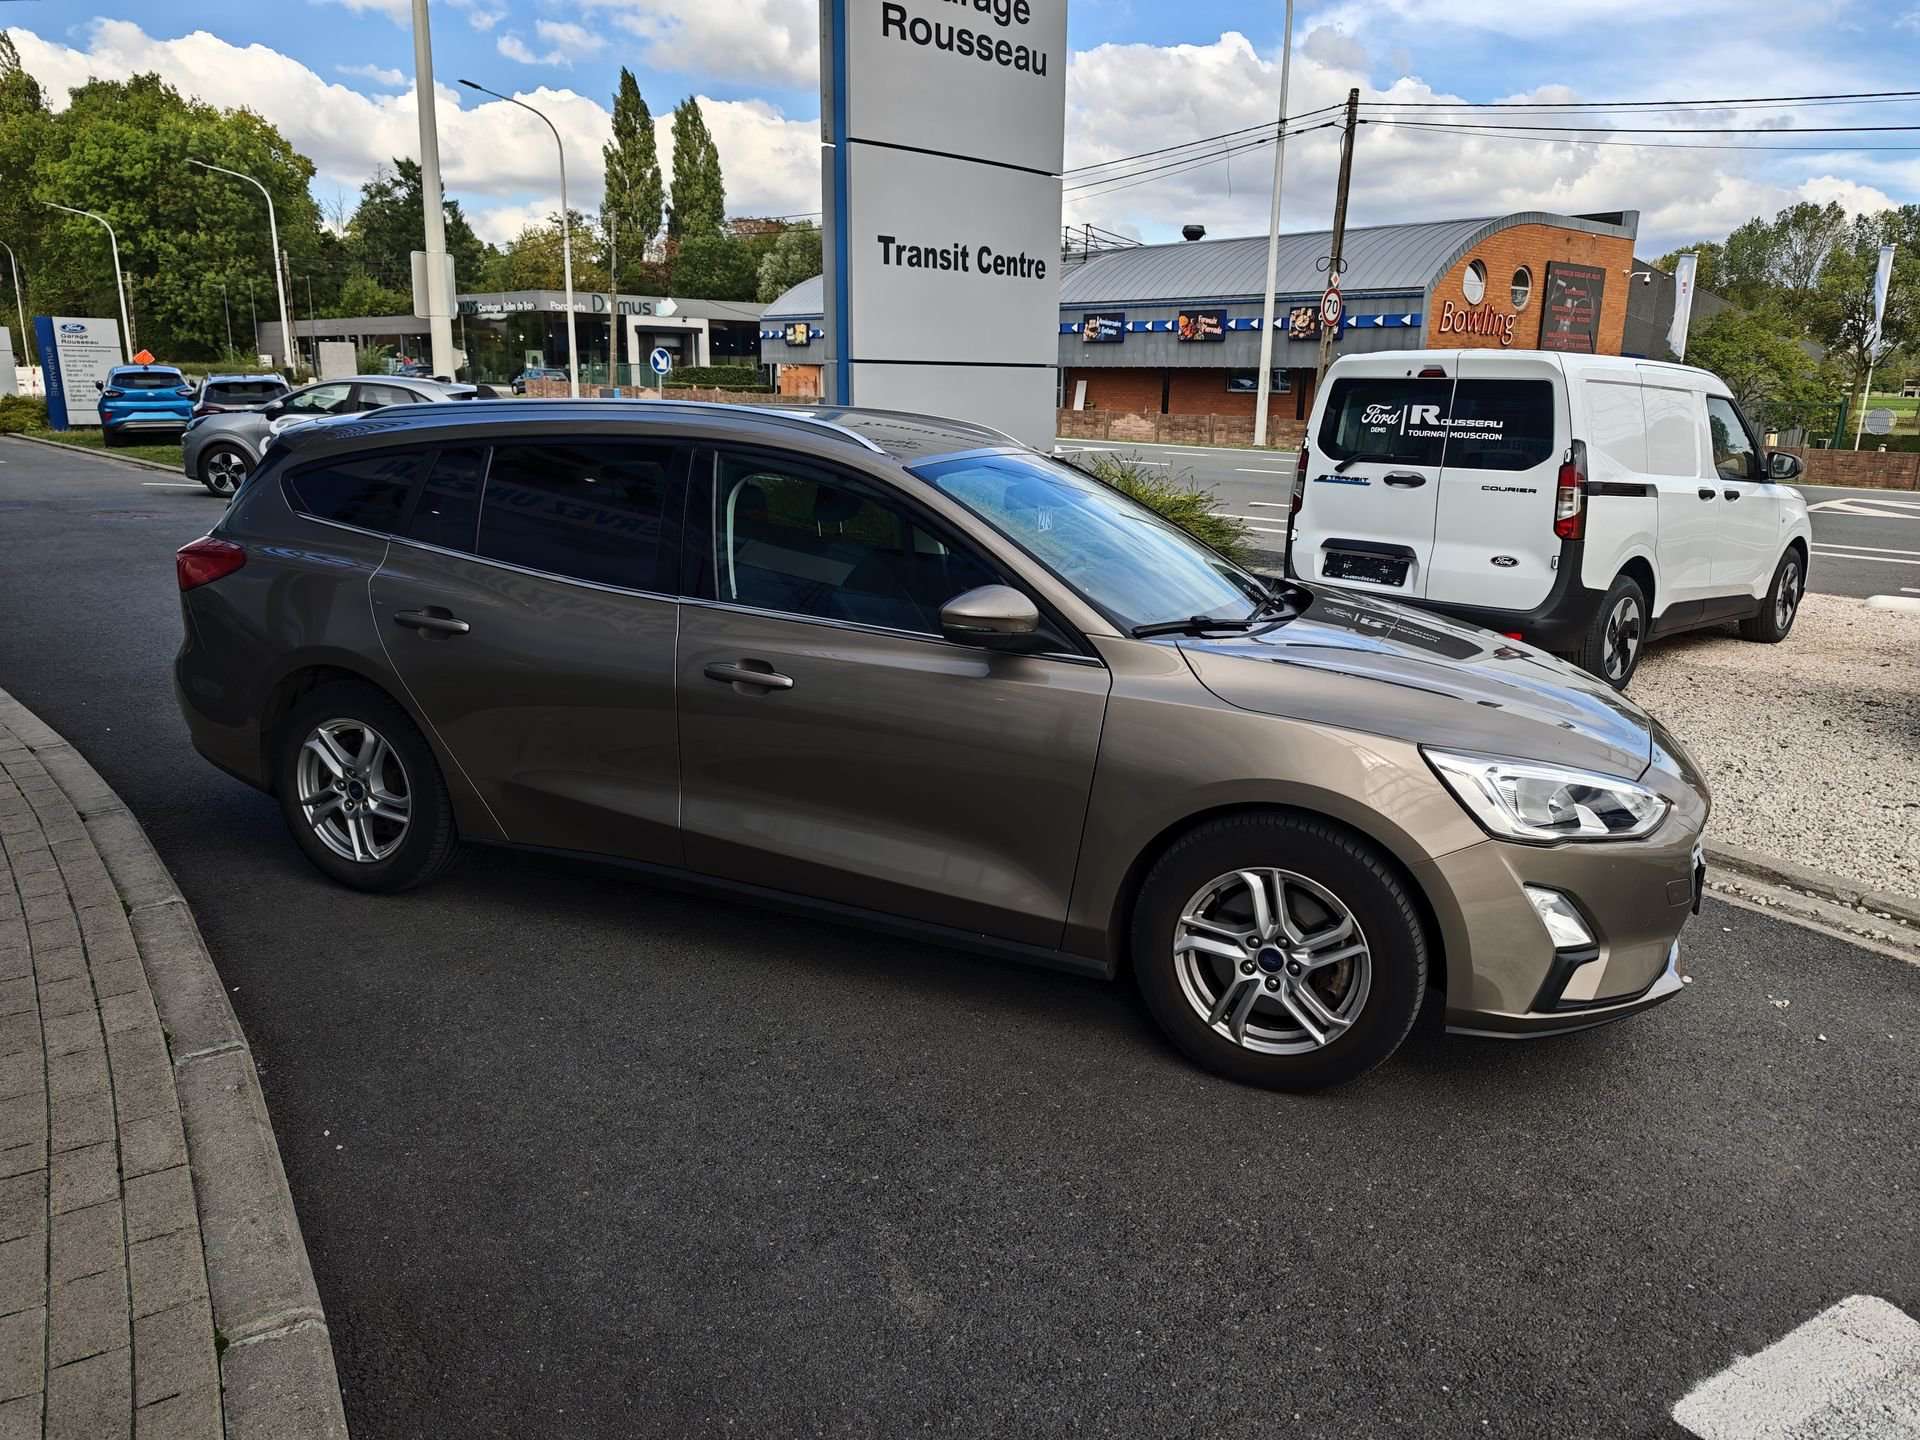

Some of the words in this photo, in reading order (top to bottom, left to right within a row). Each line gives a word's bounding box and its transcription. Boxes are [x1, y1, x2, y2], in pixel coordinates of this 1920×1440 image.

[882, 2, 1047, 77] Rousseau
[877, 235, 969, 272] Transit
[977, 246, 1046, 279] Centre
[1326, 299, 1339, 315] 70
[1439, 300, 1517, 345] Bowling
[1361, 404, 1401, 424] Ford
[1410, 404, 1503, 428] ROUSSEAU
[1408, 429, 1446, 438] TOURNAI
[1449, 431, 1503, 440] MOUSCRON
[1481, 485, 1537, 493] COURIER
